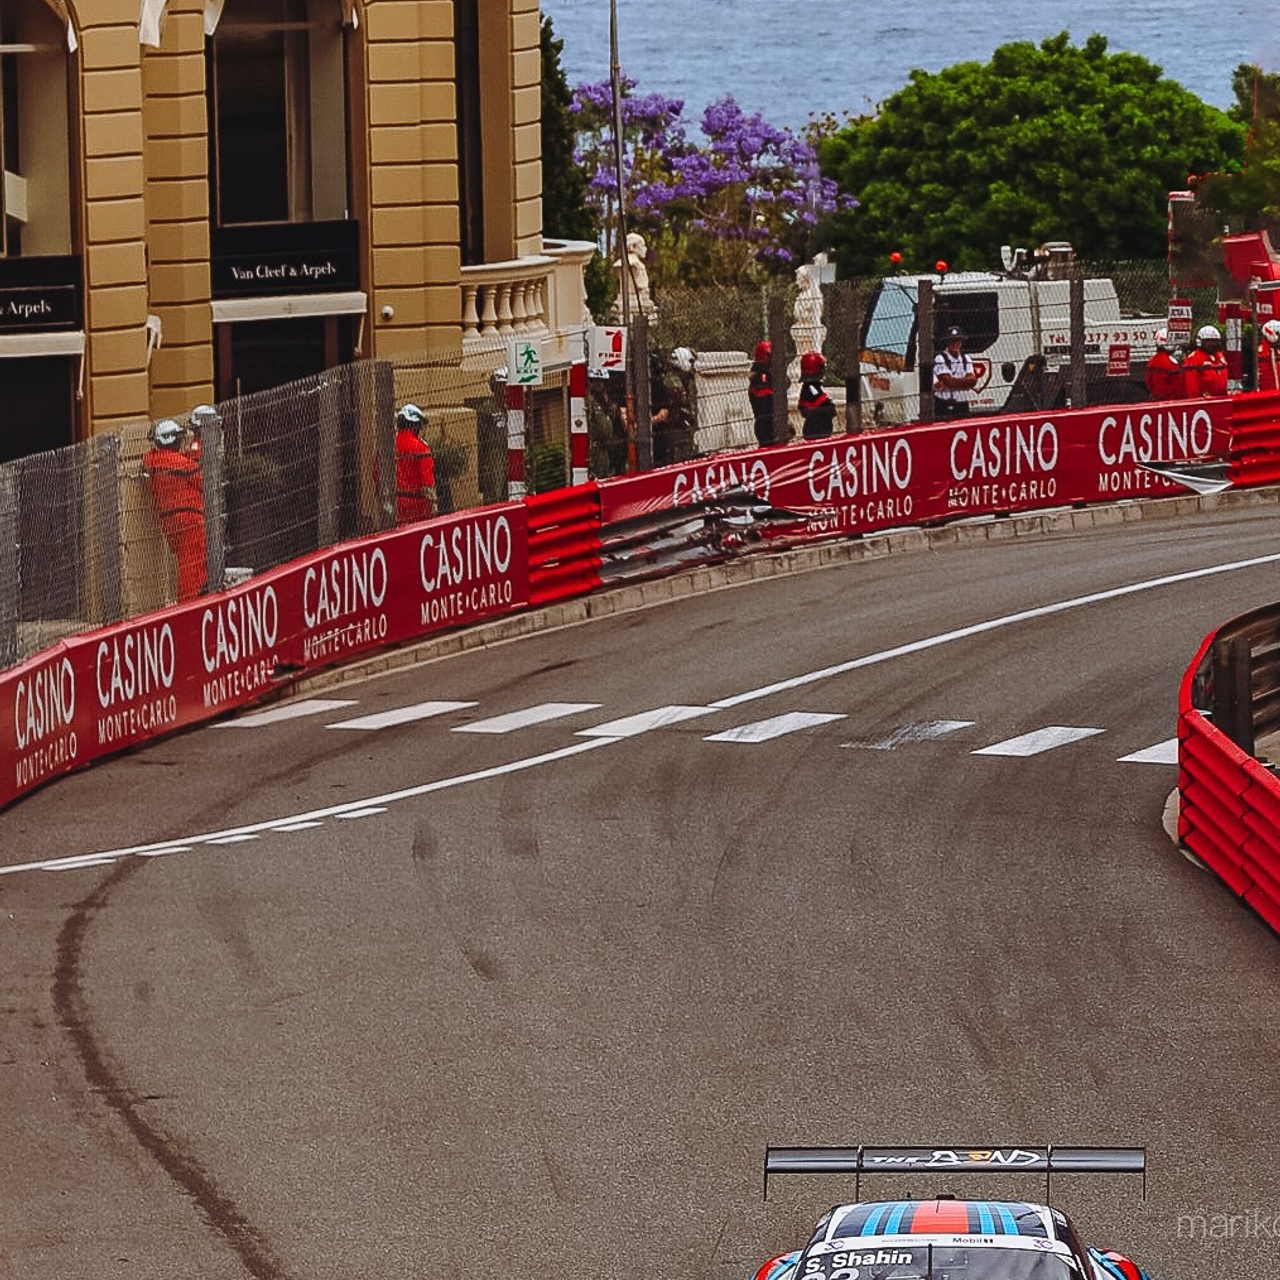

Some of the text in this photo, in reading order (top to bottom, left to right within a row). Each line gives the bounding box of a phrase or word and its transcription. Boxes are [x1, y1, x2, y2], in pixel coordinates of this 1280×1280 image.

[231, 266, 254, 280] Van
[256, 264, 287, 278] Cleef
[300, 261, 336, 280] Arpels
[6, 299, 51, 318] Arpels
[950, 421, 1059, 481] CASINO
[1098, 409, 1213, 466] CASINO
[808, 438, 912, 502] CASINO
[1008, 477, 1057, 502] CARLO
[1098, 469, 1152, 493] MONTE
[866, 494, 913, 522] CARLO
[420, 515, 512, 593] CASINO
[303, 547, 387, 628] CASINO
[421, 580, 513, 626] MONTE CARLO
[202, 585, 278, 673] CASINO
[303, 613, 387, 662] MONTE CARLO
[97, 623, 175, 709] CASINO
[203, 670, 240, 708] MONTE
[15, 657, 75, 750] CASINO
[98, 694, 177, 744] MONTE CARLO
[16, 731, 77, 788] MONTE CARLO
[805, 1257, 826, 1273] S.
